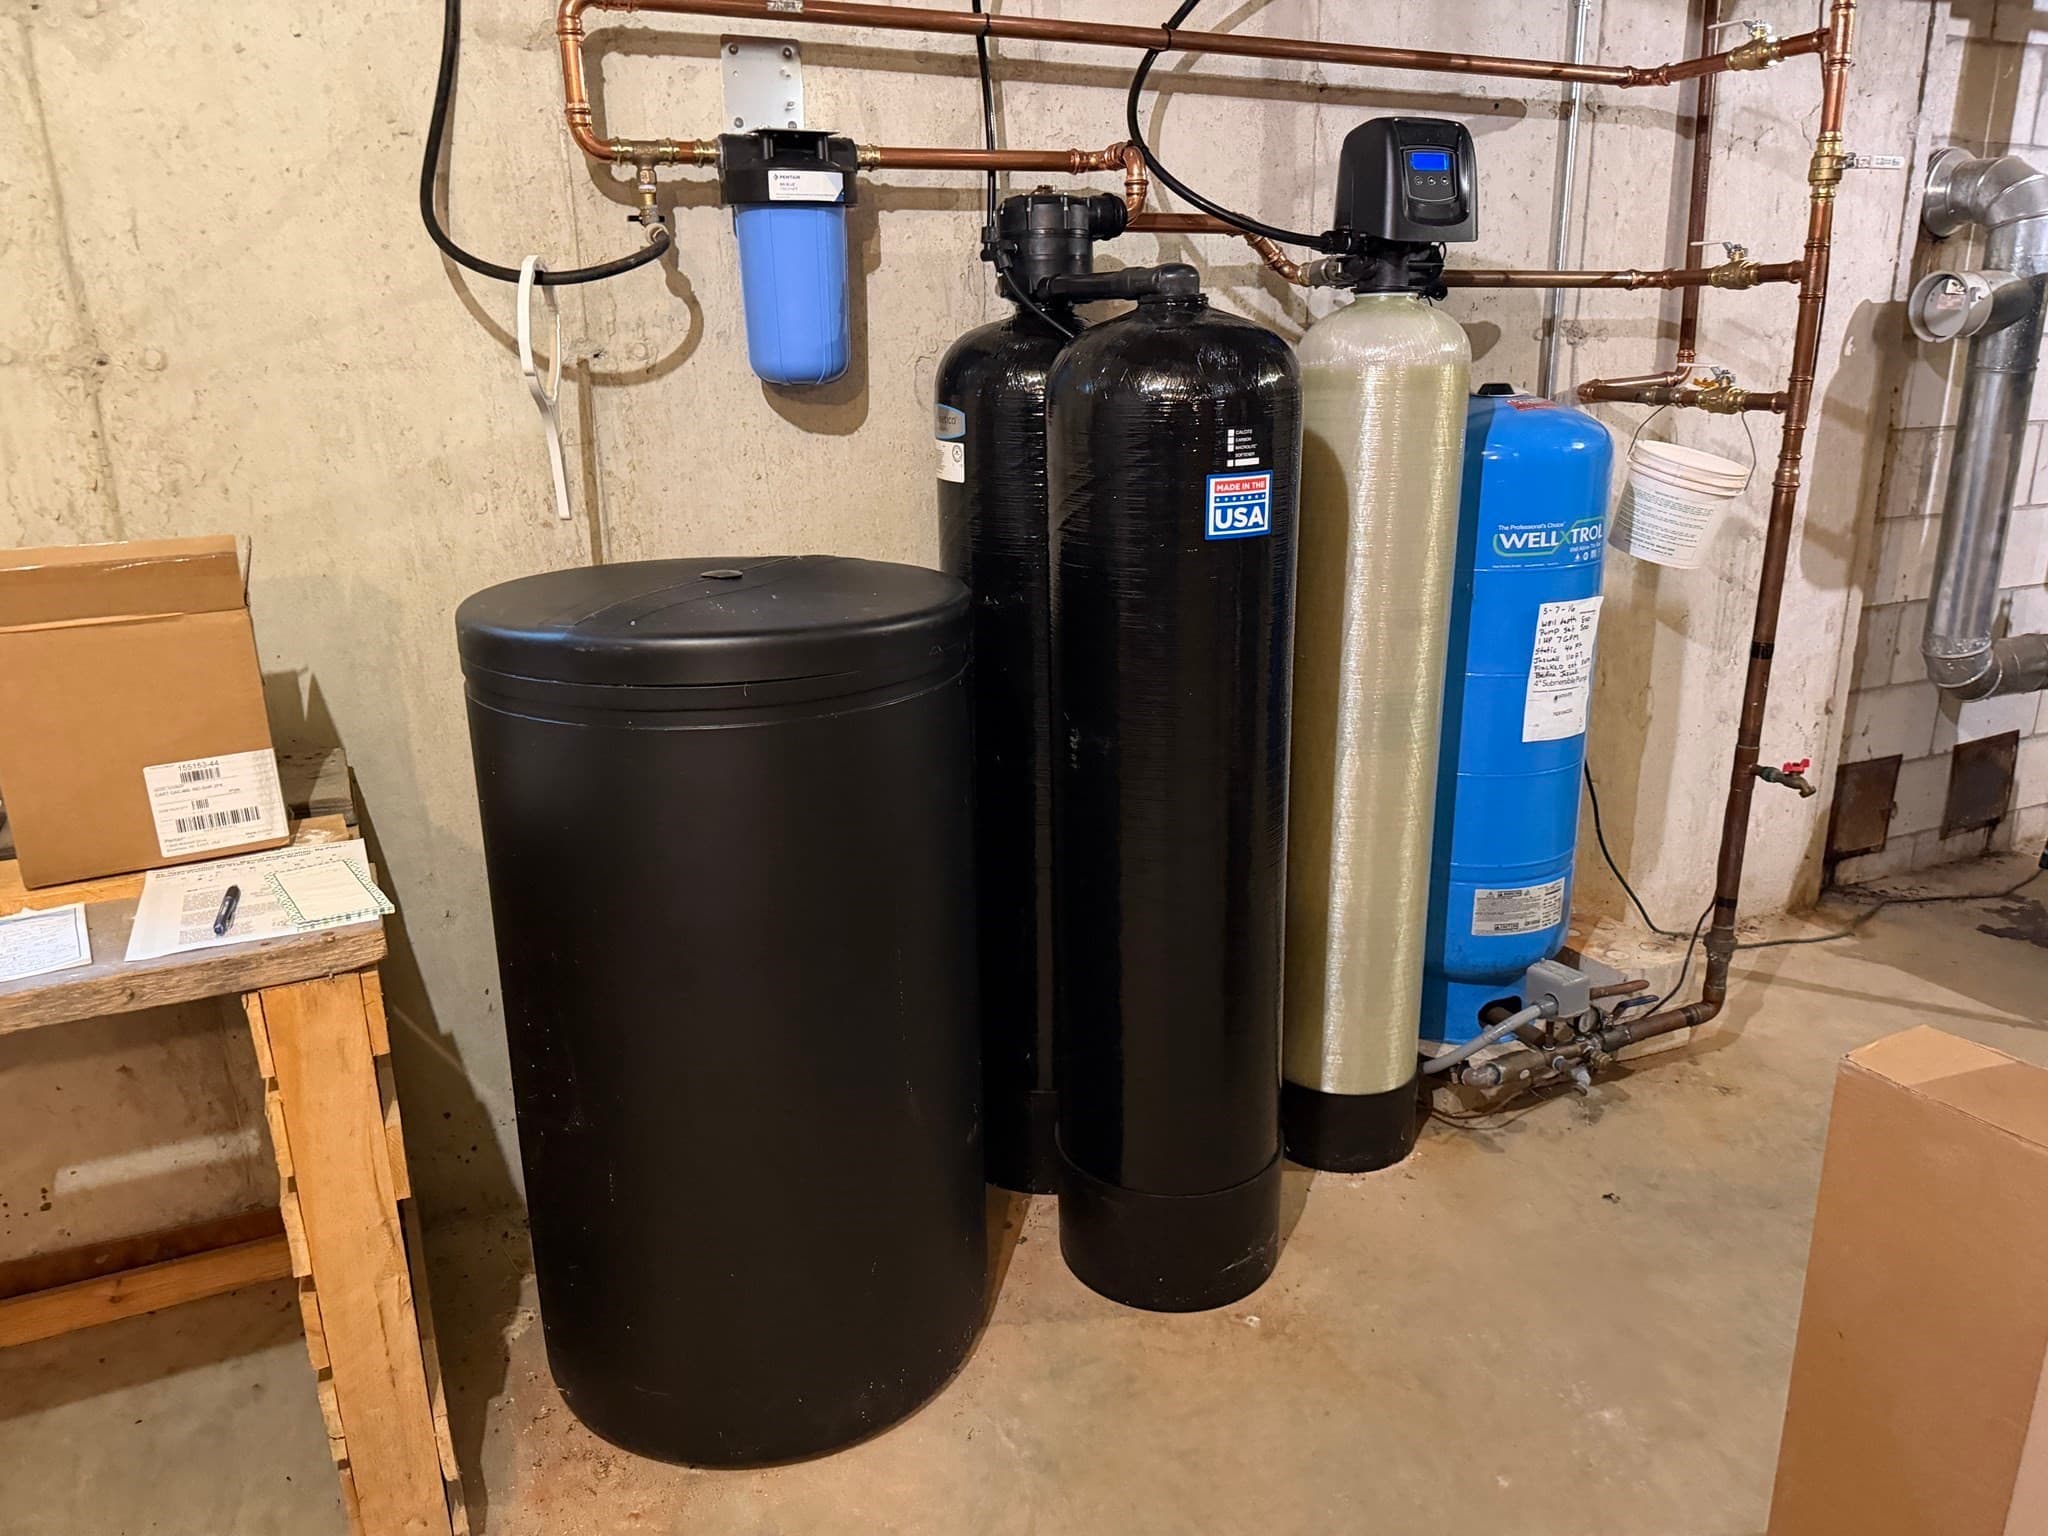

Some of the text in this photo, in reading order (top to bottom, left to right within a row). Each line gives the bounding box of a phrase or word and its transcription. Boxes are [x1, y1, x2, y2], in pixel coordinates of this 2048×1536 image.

[1216, 480, 1265, 492] MADE IN THE
[1215, 506, 1265, 529] USA
